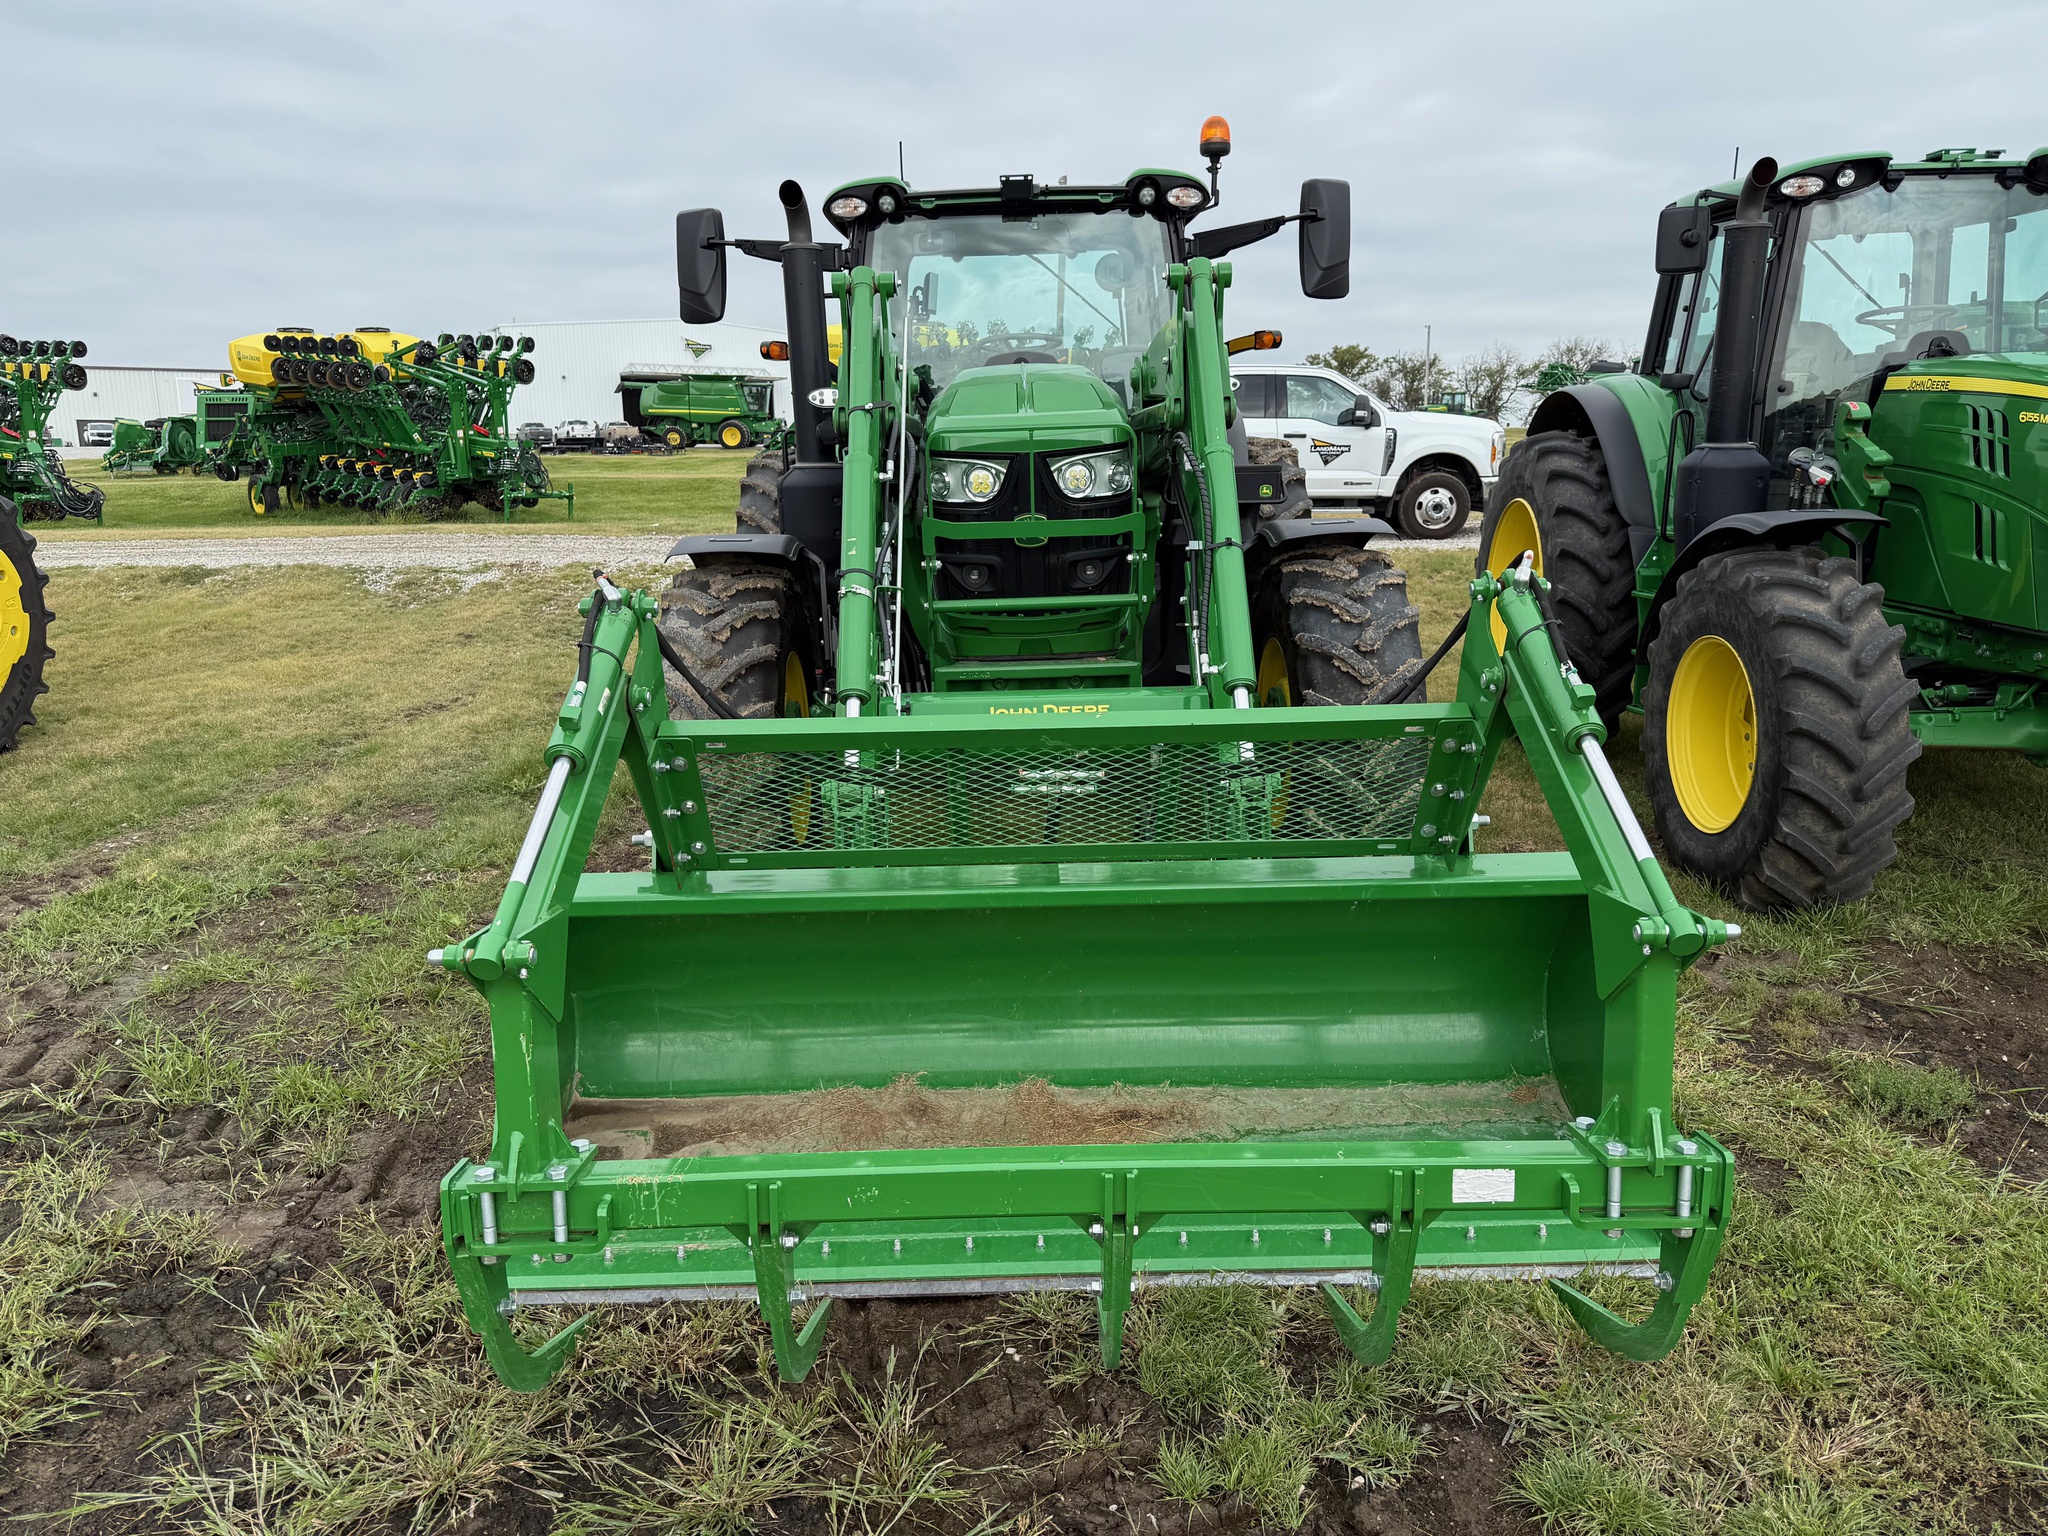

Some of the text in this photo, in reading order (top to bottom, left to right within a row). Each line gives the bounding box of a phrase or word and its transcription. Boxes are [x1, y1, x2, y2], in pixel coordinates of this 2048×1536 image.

[249, 354, 261, 362] DEERE
[1906, 378, 1951, 391] JOHN DEERE
